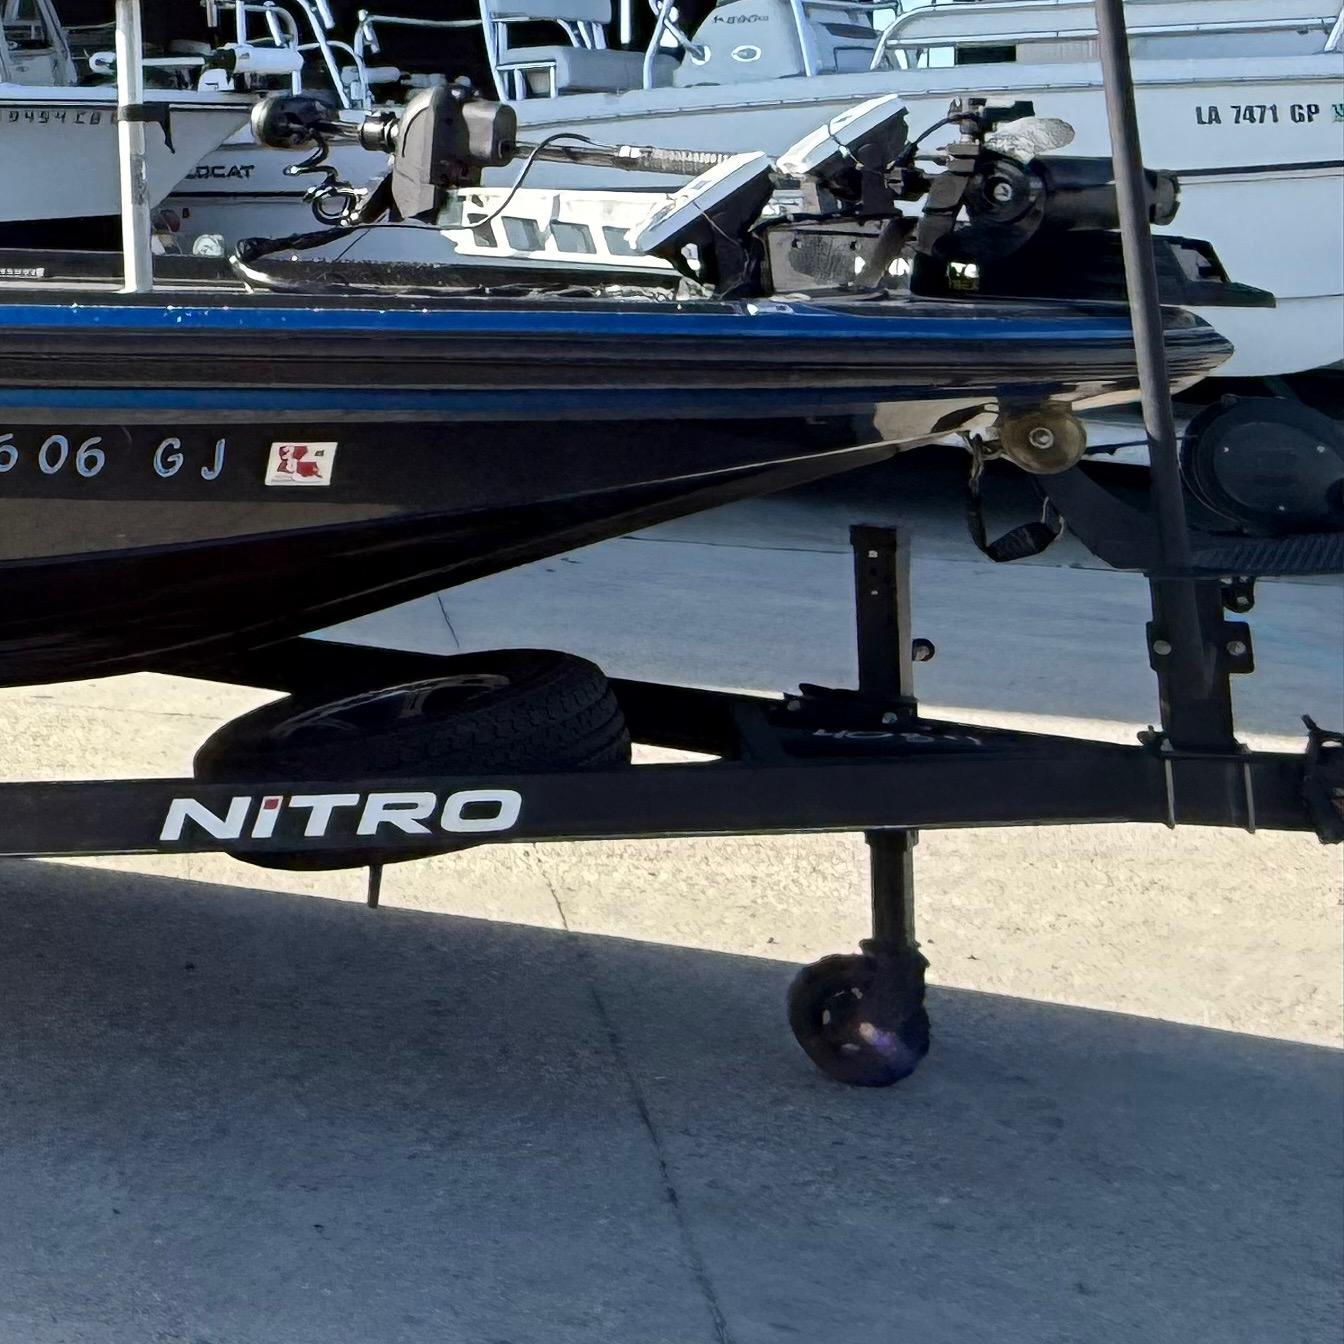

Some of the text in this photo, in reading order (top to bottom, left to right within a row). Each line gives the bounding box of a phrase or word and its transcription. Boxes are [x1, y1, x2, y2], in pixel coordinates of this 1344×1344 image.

[1195, 103, 1320, 125] LA 7471 GP
[152, 437, 225, 481] GJ
[159, 789, 522, 842] NITRO
